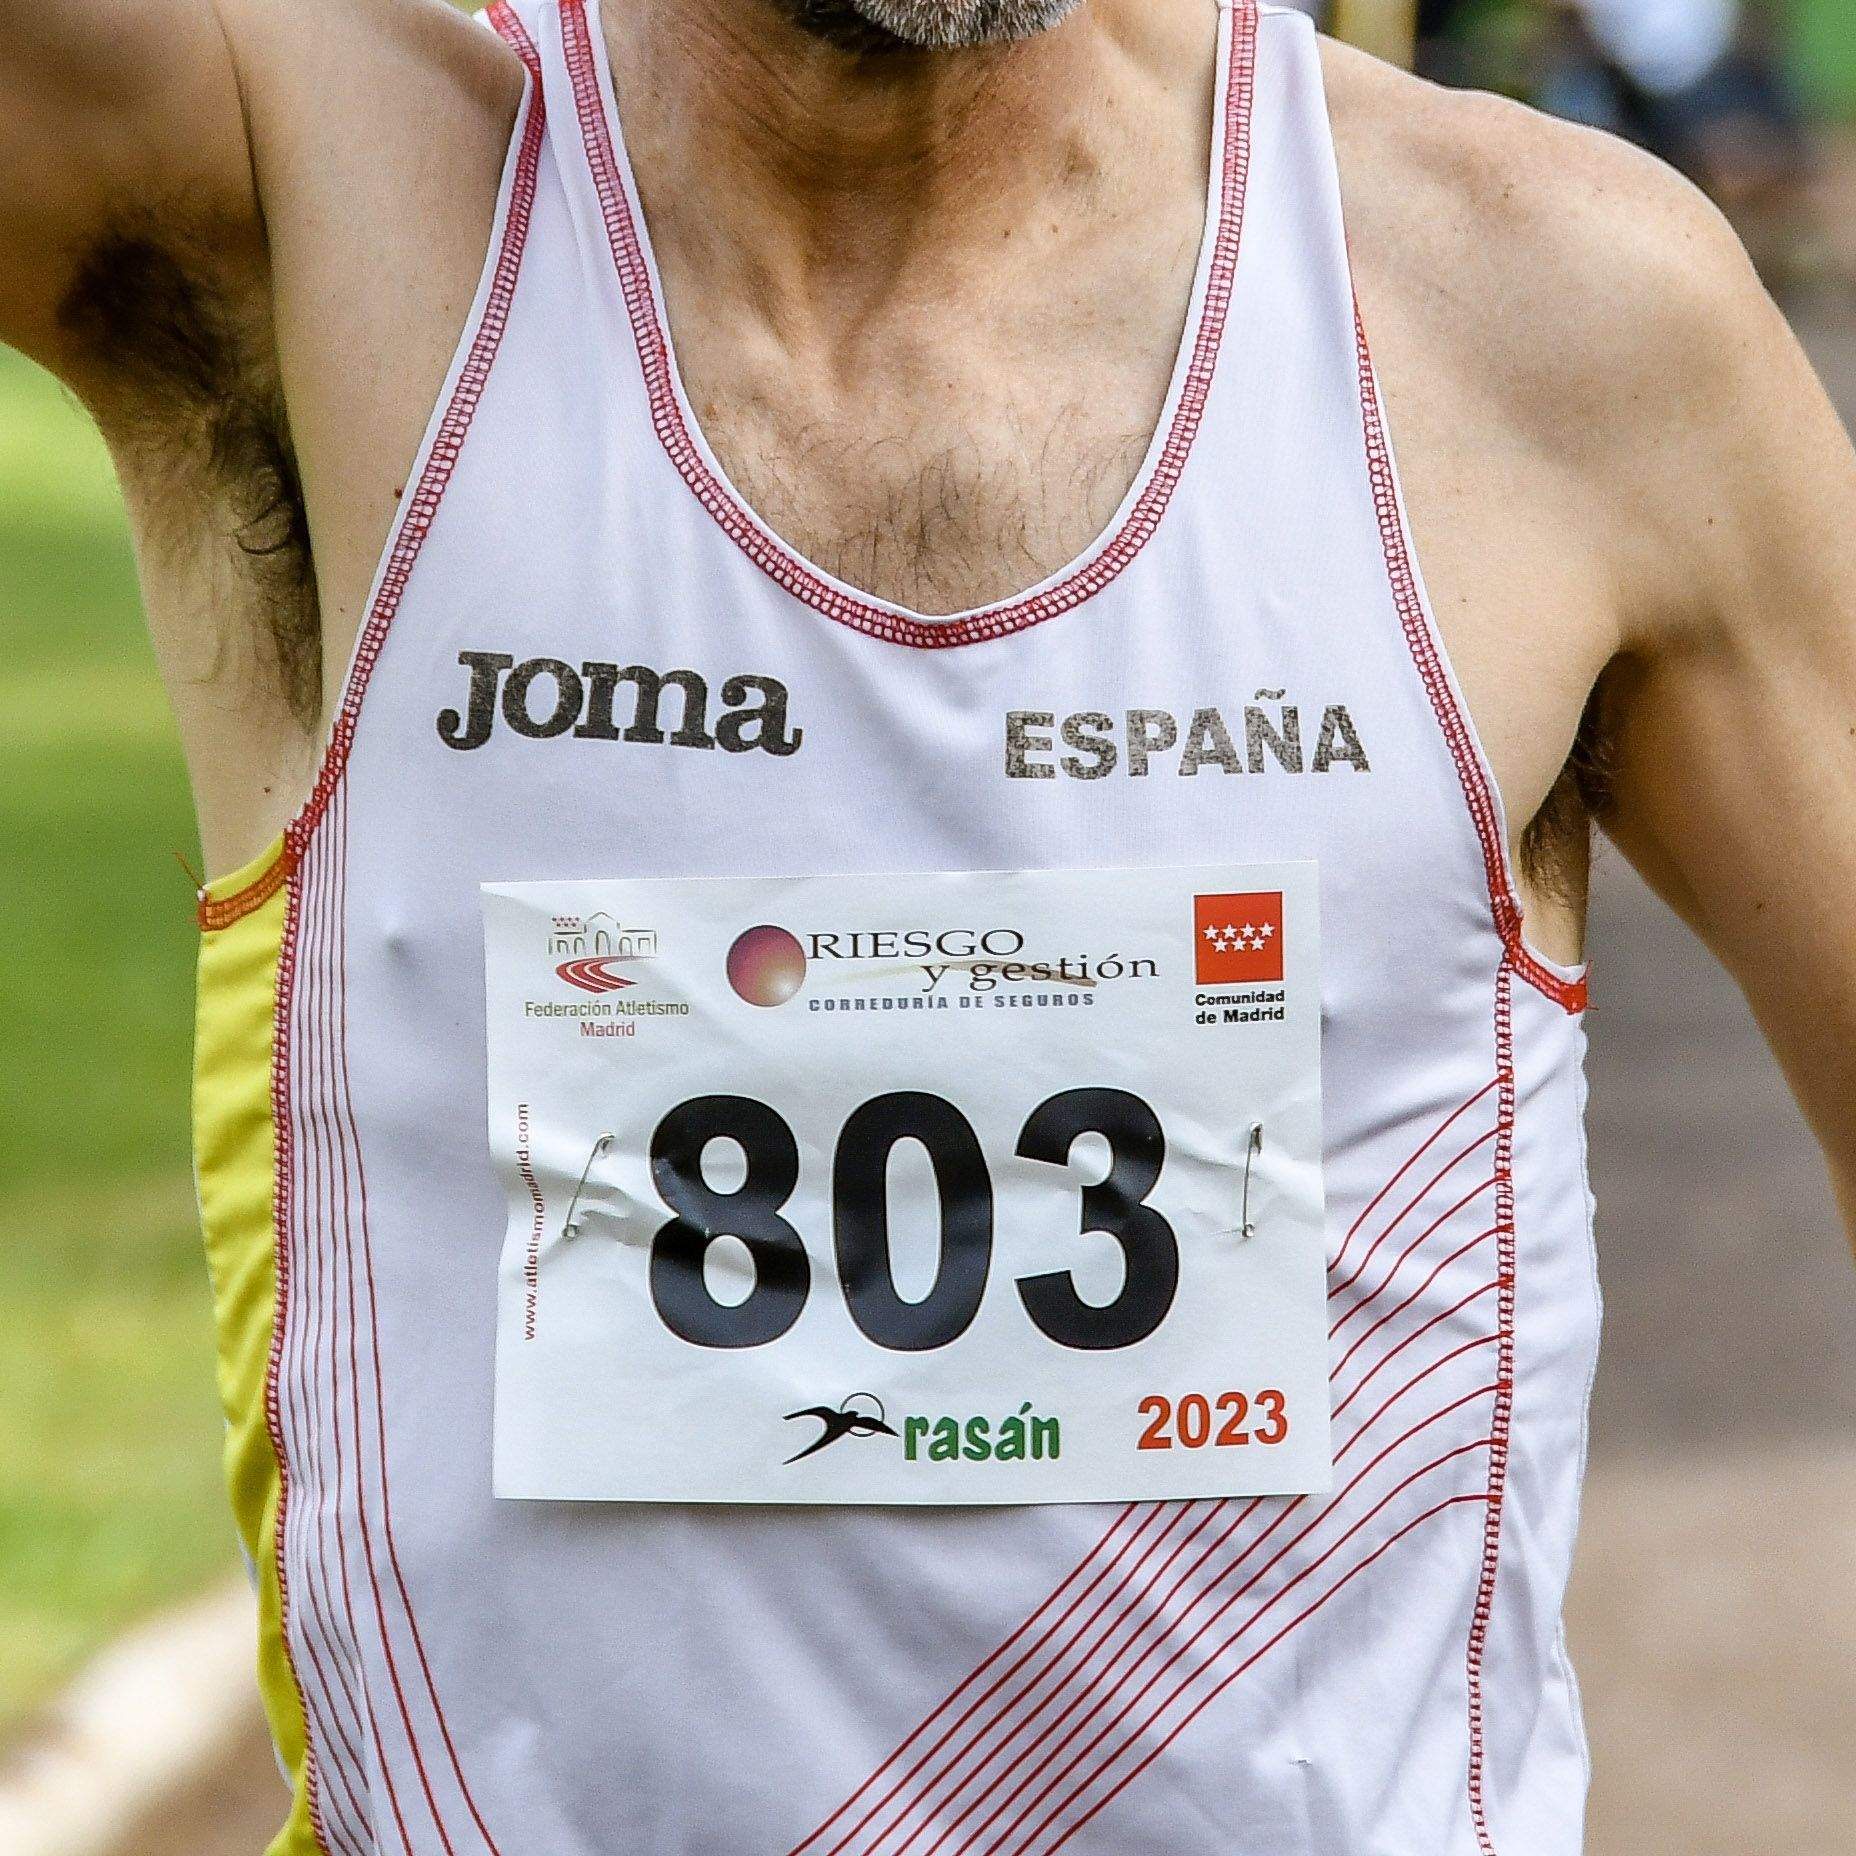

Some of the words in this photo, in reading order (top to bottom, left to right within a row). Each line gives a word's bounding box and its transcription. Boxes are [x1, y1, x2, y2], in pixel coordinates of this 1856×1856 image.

[435, 649, 803, 756] Joma
[1004, 687, 1372, 780] ESPAÑA
[806, 928, 1025, 960] RIESGO
[921, 963, 951, 993] y
[969, 953, 1160, 992] gestión
[525, 999, 611, 1017] Federación
[615, 999, 690, 1017] Atletismo
[808, 994, 949, 1012] CORREDURÍA
[959, 995, 984, 1010] DE
[993, 992, 1095, 1009] SEGUROS
[1195, 990, 1285, 1006] Comunidad
[1195, 1010, 1217, 1025] de
[1223, 1006, 1285, 1023] Madrid
[579, 1020, 636, 1037] Madrid
[647, 1086, 1180, 1352] 803
[903, 1401, 1061, 1462] rasán
[1135, 1388, 1289, 1451] 2023
